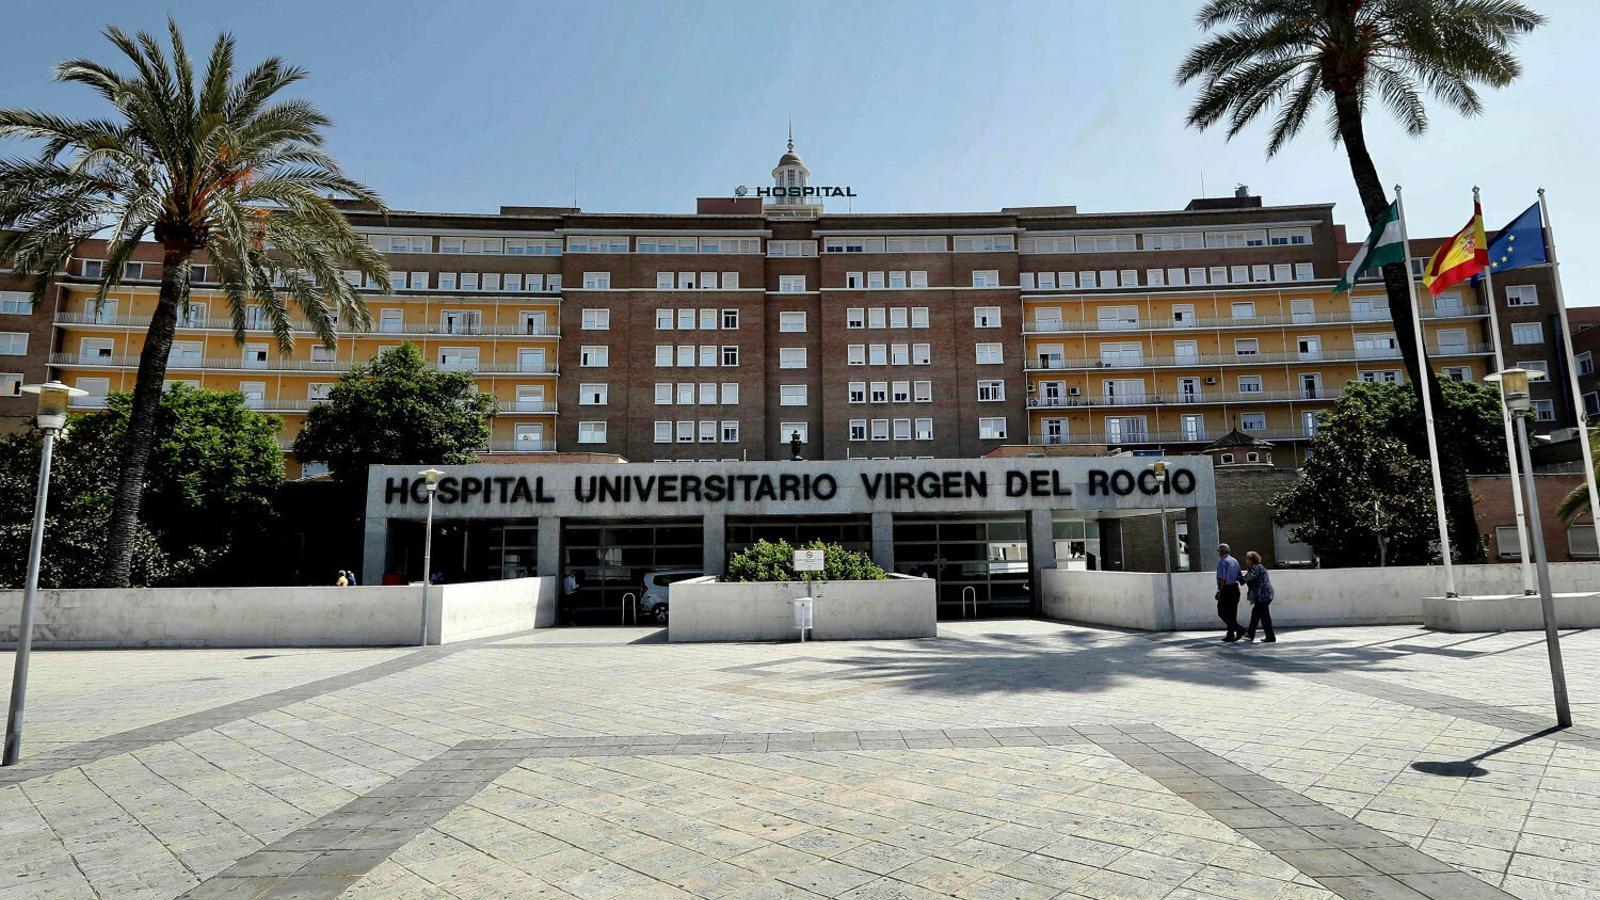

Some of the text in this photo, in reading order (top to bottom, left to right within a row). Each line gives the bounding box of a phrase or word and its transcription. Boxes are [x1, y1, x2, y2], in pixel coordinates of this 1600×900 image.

[757, 186, 857, 197] HOSPITAL
[385, 468, 1197, 503] HOSPITAL UNIVERSITARIO VIRGEN DEL ROCIO
